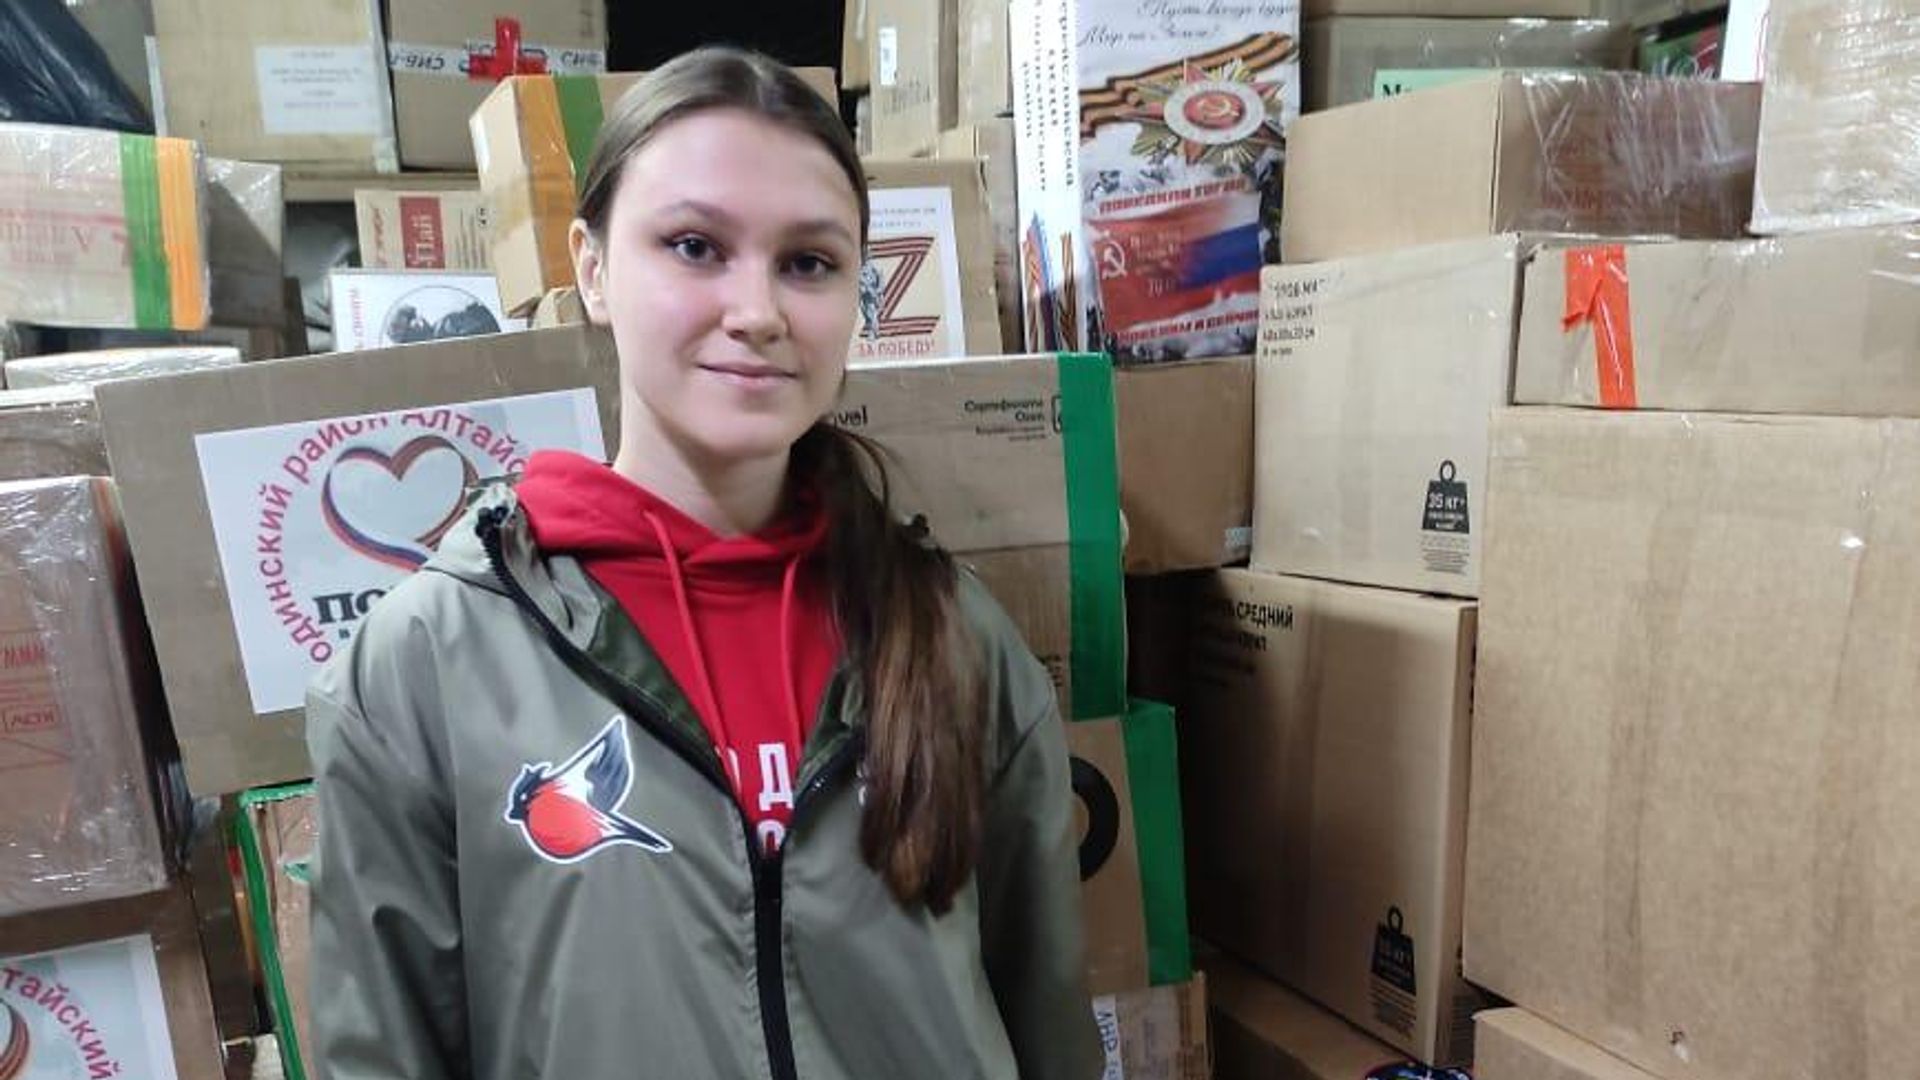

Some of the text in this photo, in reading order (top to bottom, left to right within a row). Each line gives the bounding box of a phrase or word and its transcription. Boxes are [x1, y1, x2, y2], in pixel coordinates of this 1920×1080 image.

[837, 405, 868, 427] vel
[257, 484, 332, 663] одинский
[401, 409, 529, 474] Алтайс
[1236, 601, 1294, 631] СРЕДНИЙ
[3, 967, 122, 1080] тайский
